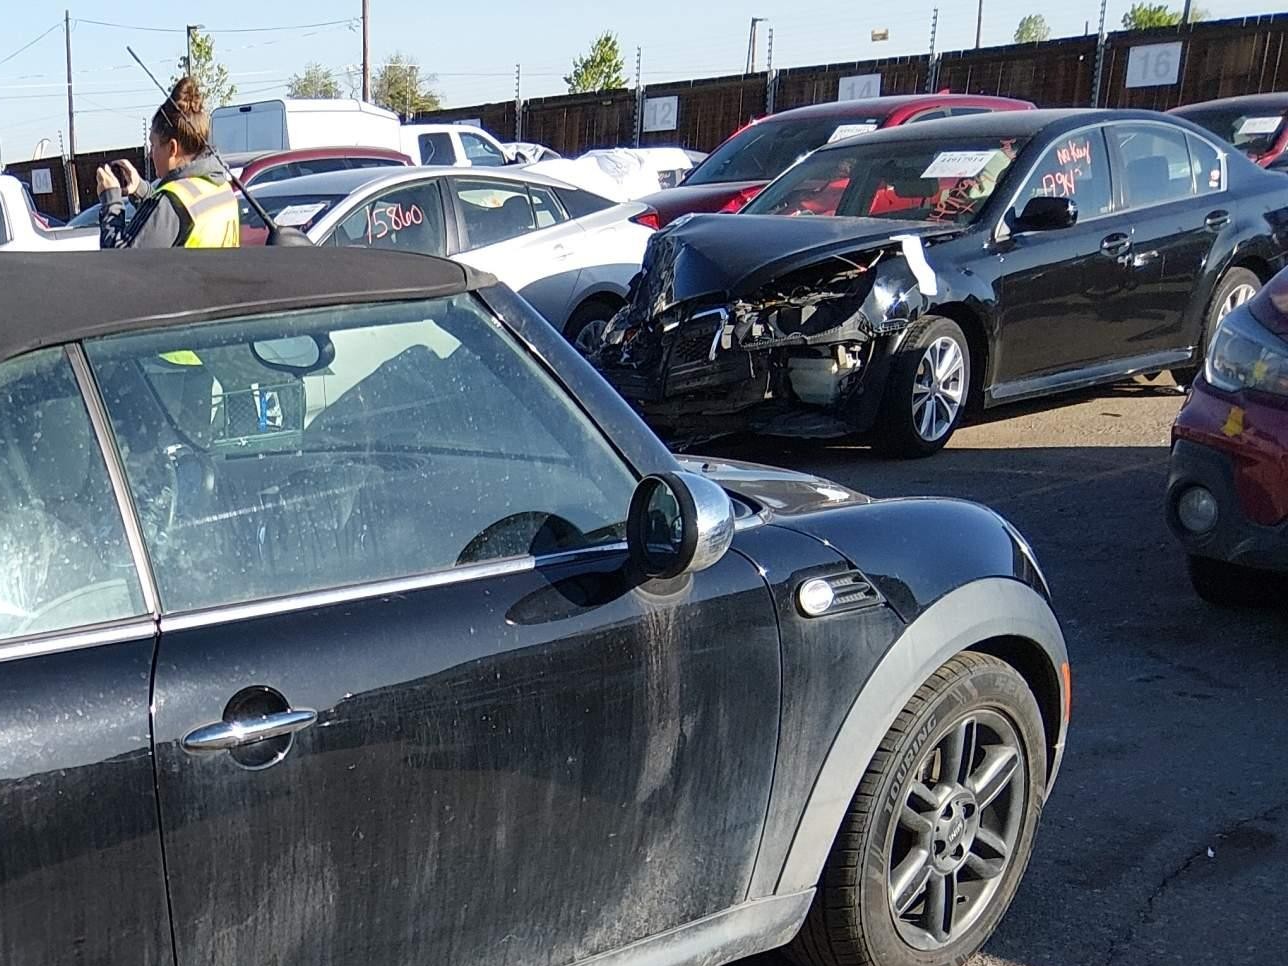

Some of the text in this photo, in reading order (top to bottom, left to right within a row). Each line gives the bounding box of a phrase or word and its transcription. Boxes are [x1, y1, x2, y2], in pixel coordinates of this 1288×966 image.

[1139, 50, 1171, 80] 16
[847, 80, 873, 100] 14
[650, 102, 673, 126] 12
[366, 203, 424, 246] 15860
[885, 714, 937, 815] TOURING
